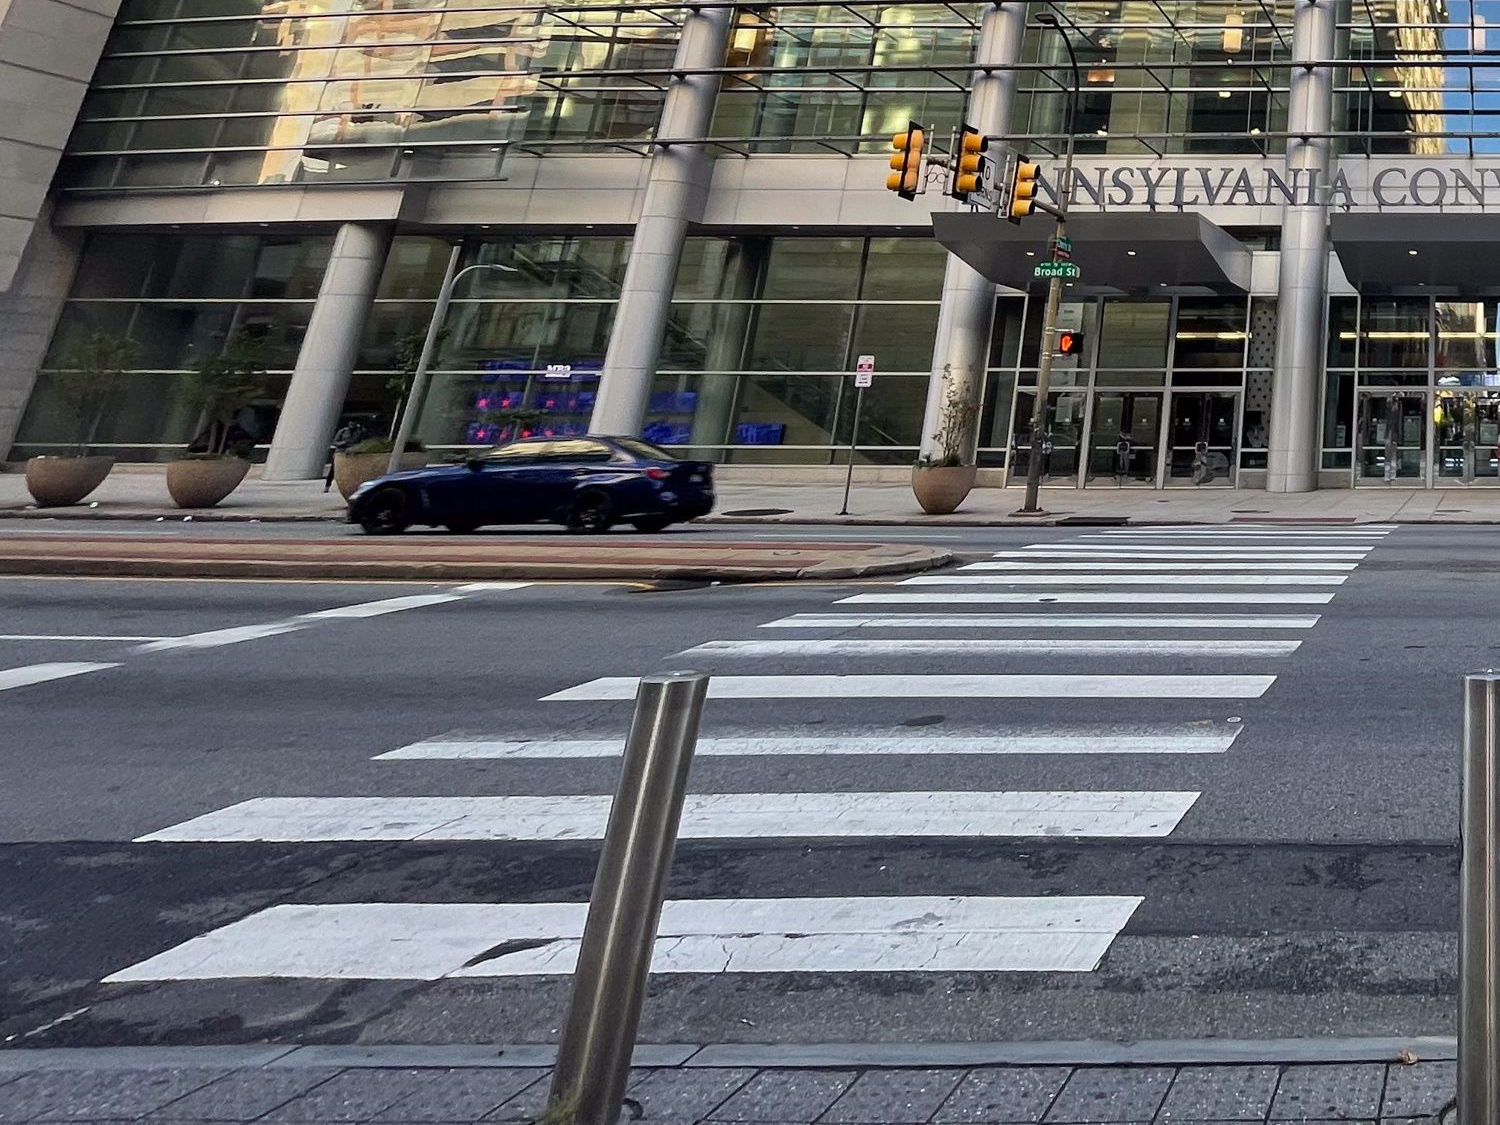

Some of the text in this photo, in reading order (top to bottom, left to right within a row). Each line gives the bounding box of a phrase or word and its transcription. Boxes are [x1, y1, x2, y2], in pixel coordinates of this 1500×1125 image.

[1037, 166, 1358, 207] NNSYLVANIA
[1034, 266, 1076, 277] Broad St
